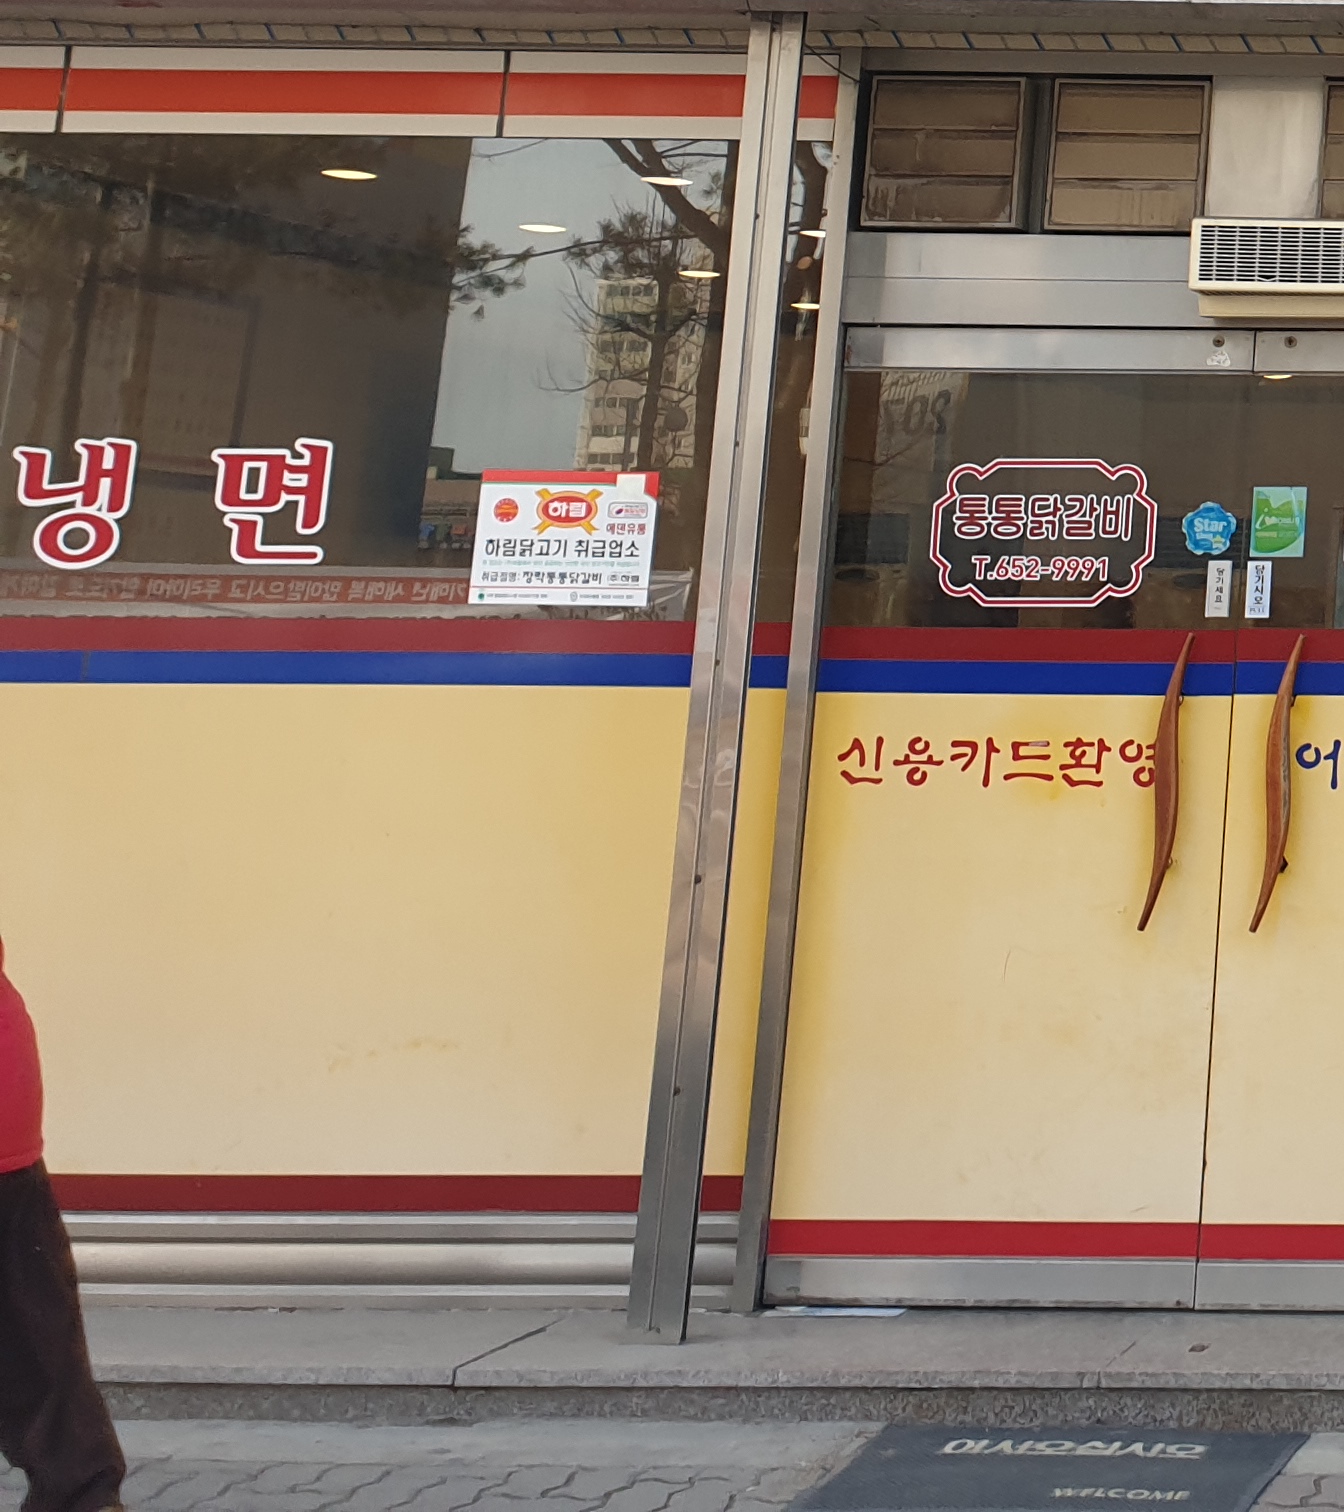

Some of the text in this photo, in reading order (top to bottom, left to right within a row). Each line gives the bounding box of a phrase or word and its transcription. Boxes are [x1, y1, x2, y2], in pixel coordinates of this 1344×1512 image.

[548, 501, 587, 518] 하림
[953, 493, 1134, 541] 통통닭갈비
[1193, 517, 1227, 533] Star
[485, 538, 640, 558] 하림닭고기 취급업소
[971, 555, 1109, 582] T.652-9991
[1052, 1488, 1192, 1501] WELCOME
